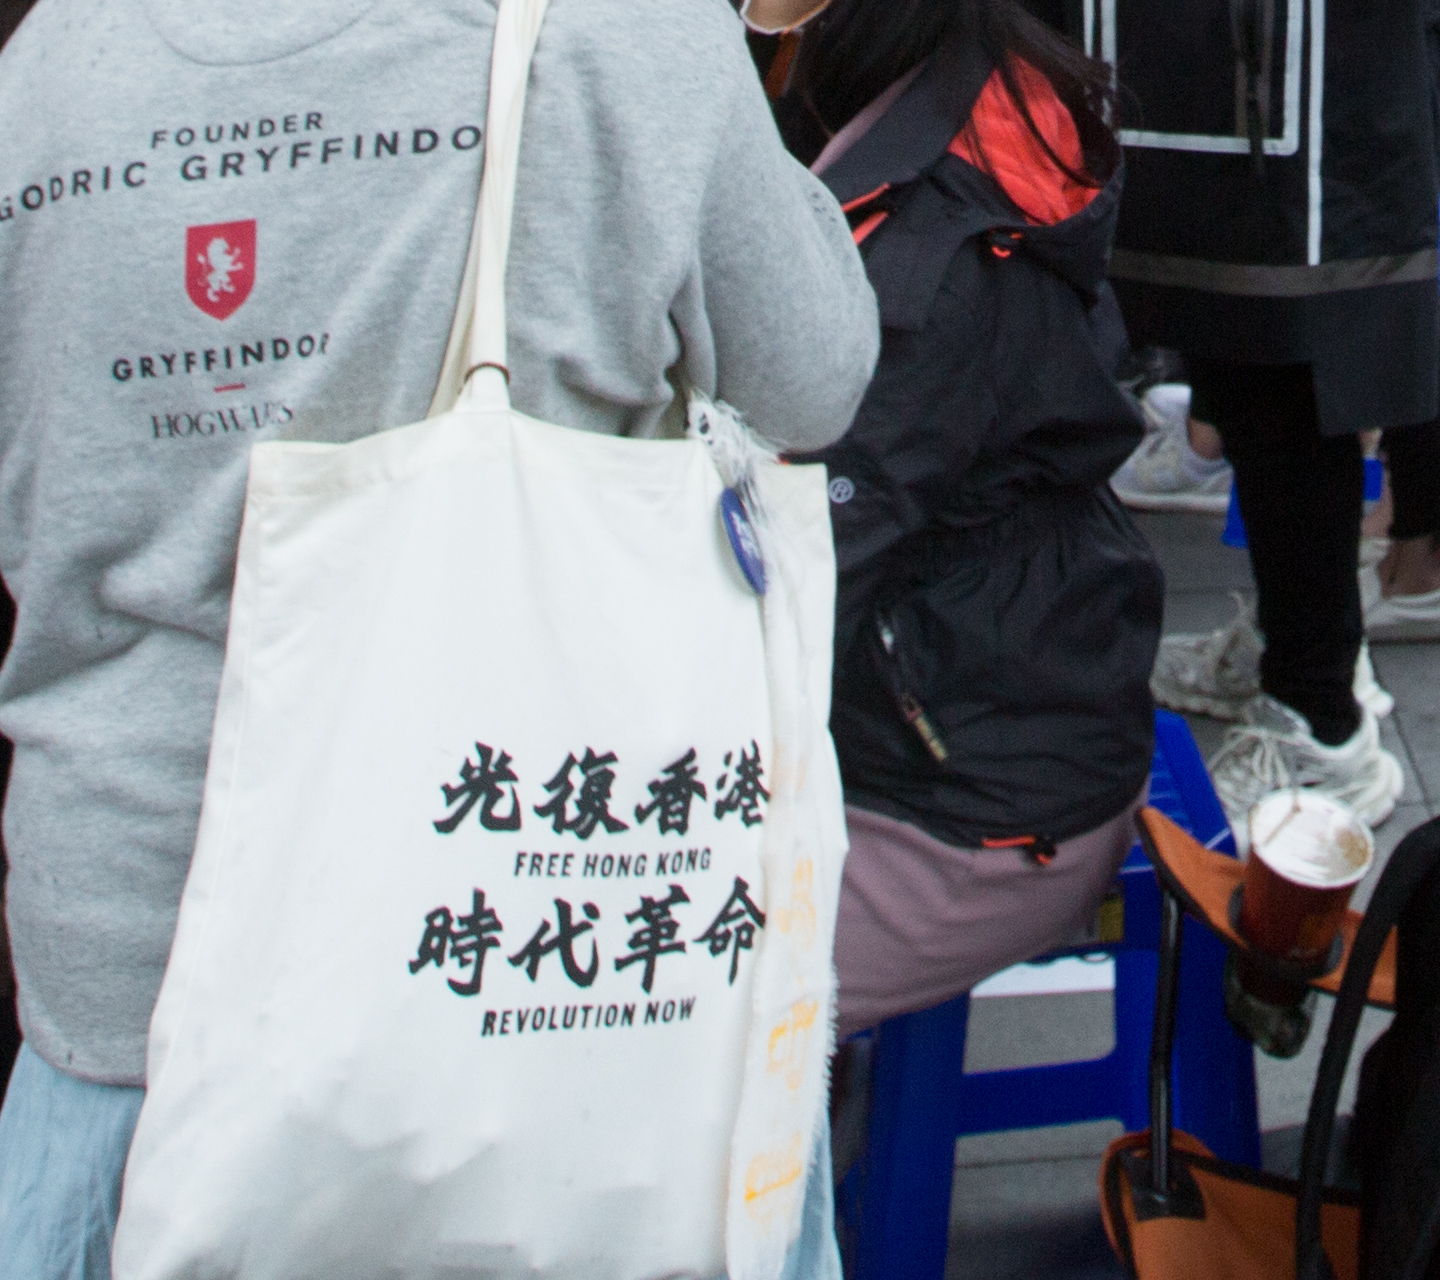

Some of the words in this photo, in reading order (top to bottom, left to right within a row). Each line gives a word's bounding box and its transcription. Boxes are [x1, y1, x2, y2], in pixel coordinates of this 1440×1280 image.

[150, 111, 324, 150] FOUNDER
[180, 124, 484, 182] GRYFFINDO
[432, 739, 772, 841] 光復香港
[514, 850, 575, 878] FREE
[582, 853, 648, 878] HONG
[655, 846, 712, 877] KONG
[407, 875, 767, 998] 時代革命
[481, 1002, 637, 1038] REVOLUTION
[643, 996, 697, 1026] NOW
